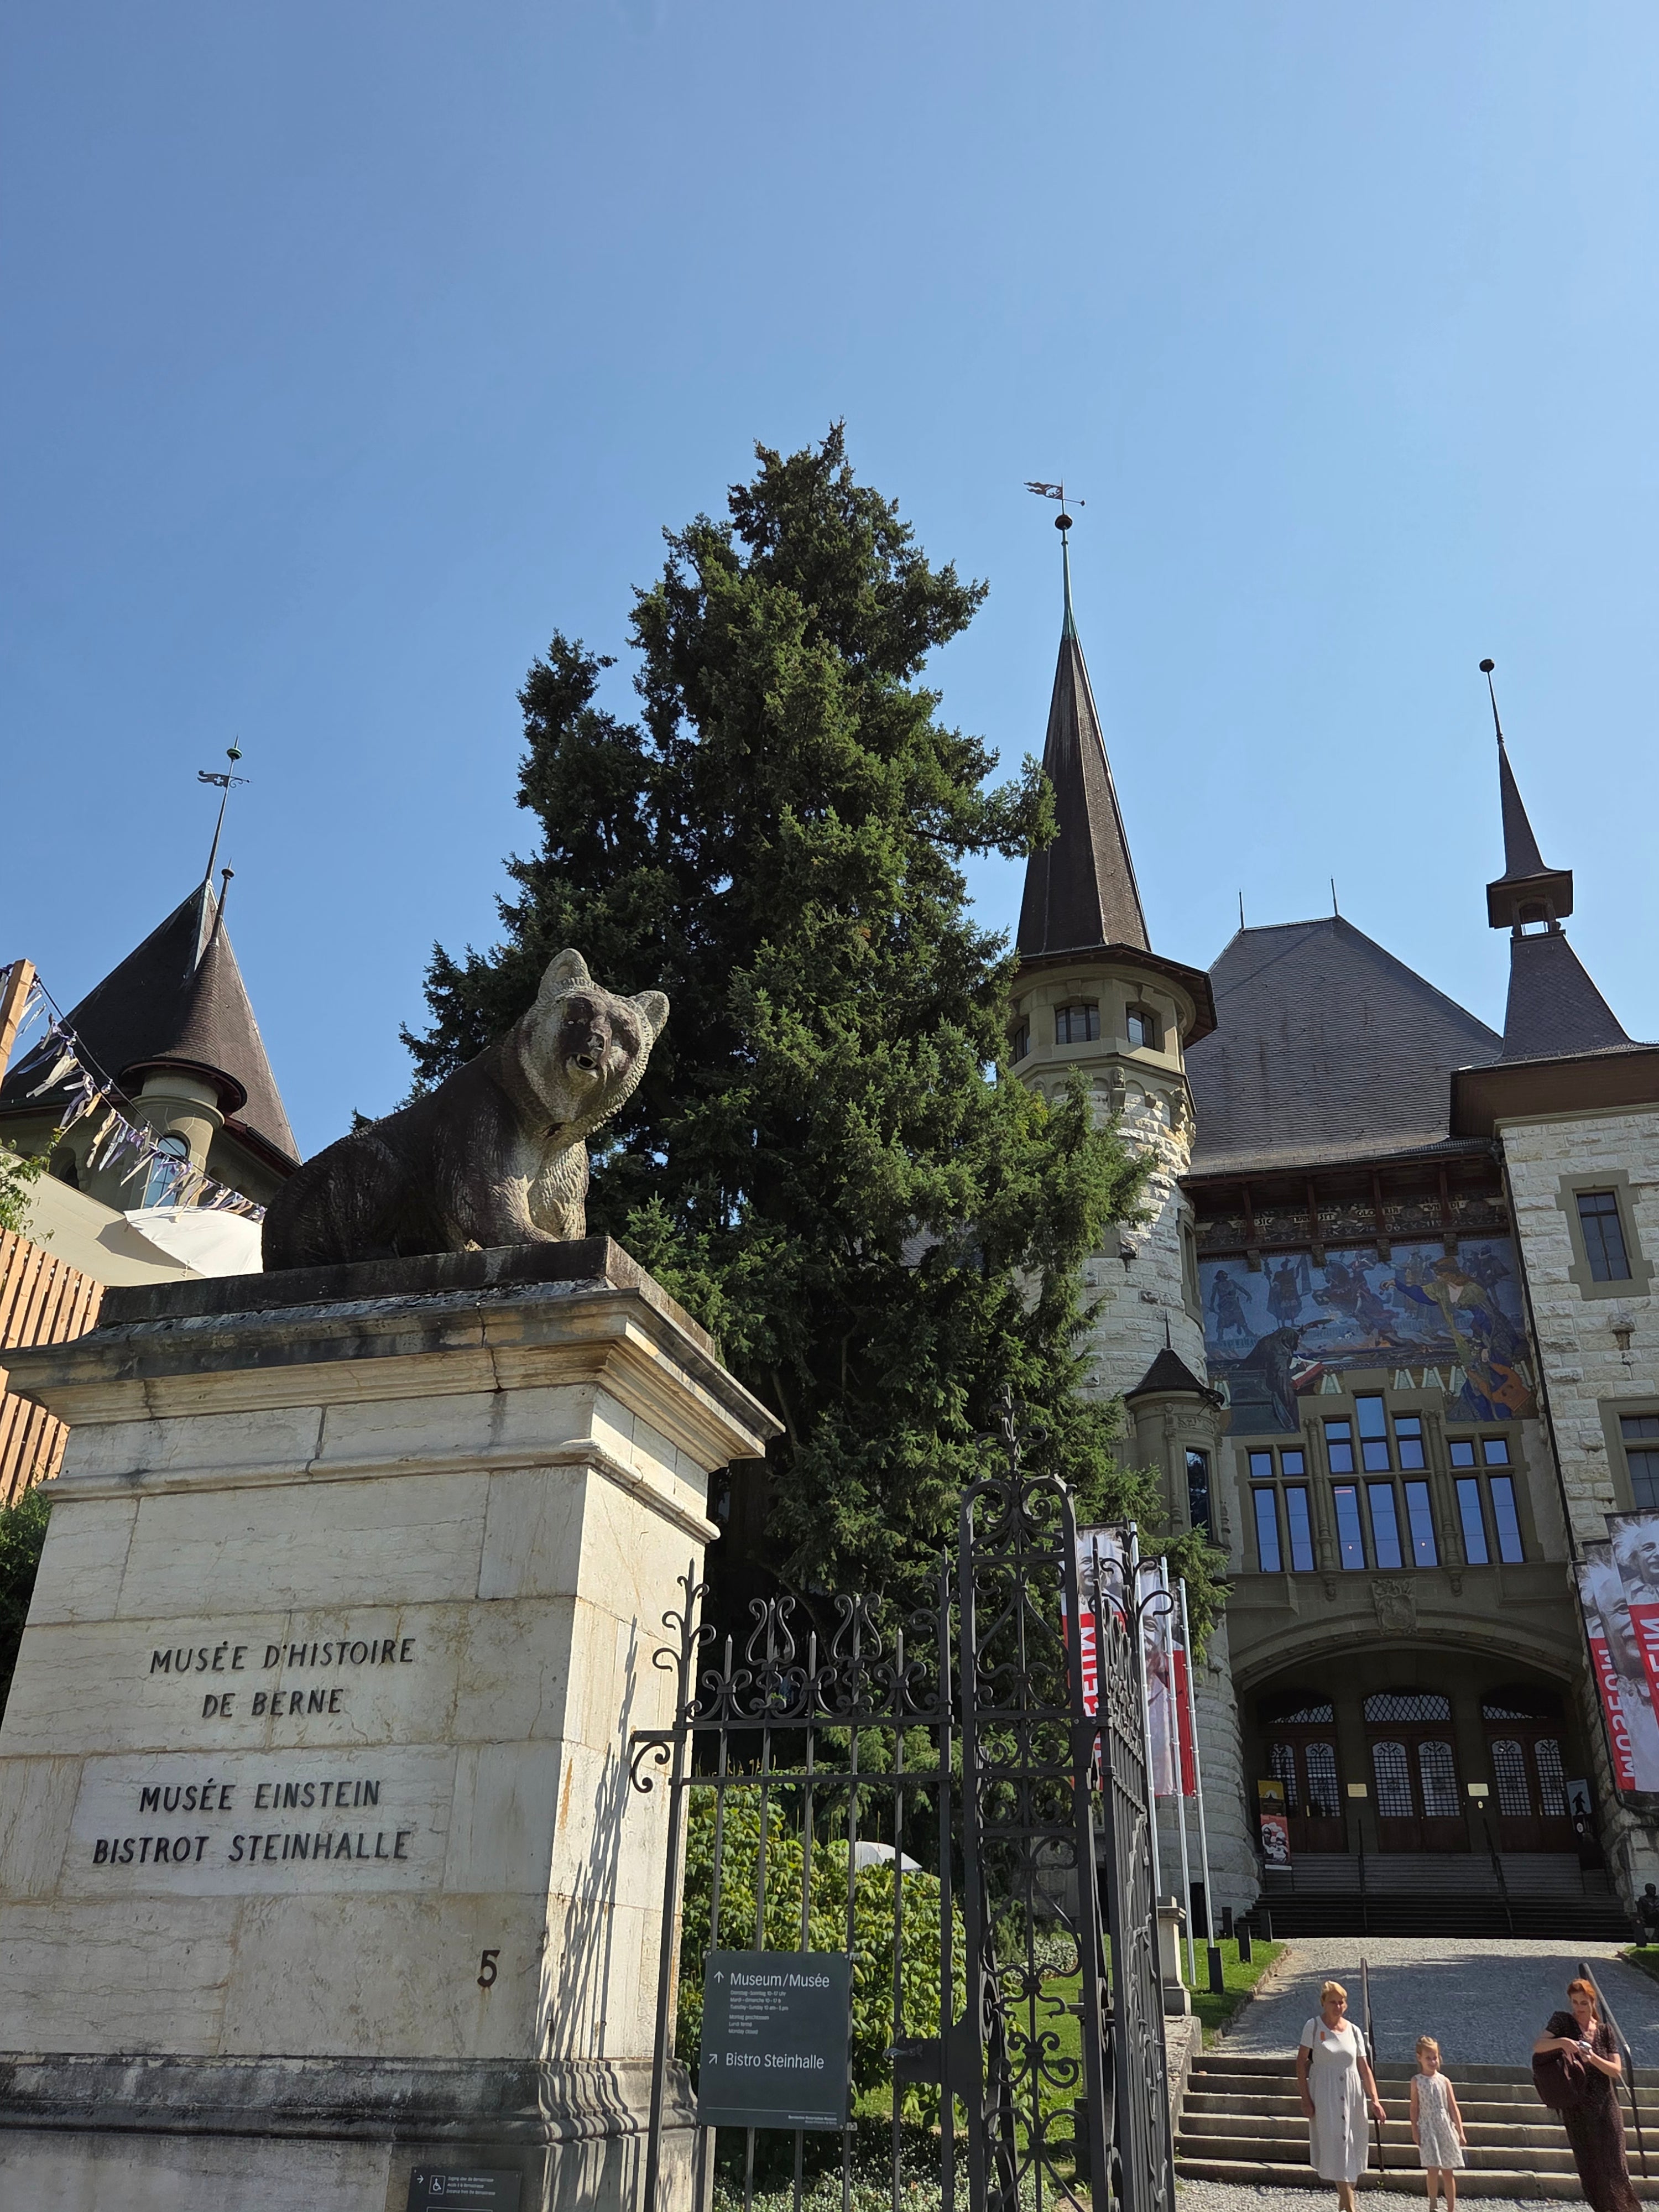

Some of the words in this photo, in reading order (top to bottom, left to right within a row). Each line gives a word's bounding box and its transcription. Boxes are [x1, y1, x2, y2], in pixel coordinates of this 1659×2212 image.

[149, 1640, 248, 1674] MUSÉE
[262, 1638, 416, 1669] D'HISTOIRE
[201, 1693, 236, 1719] DE
[251, 1688, 344, 1718] BERNE
[138, 1777, 236, 1813] MUSÉE
[253, 1779, 382, 1810] EINSTEIN
[92, 1835, 210, 1865] BISTROT
[227, 1830, 411, 1863] STEINHALLE
[477, 1949, 500, 1988] 5
[730, 1973, 830, 1988] Museum/Musée
[726, 2052, 761, 2068] Bistro
[764, 2054, 825, 2069] Steinhalle
